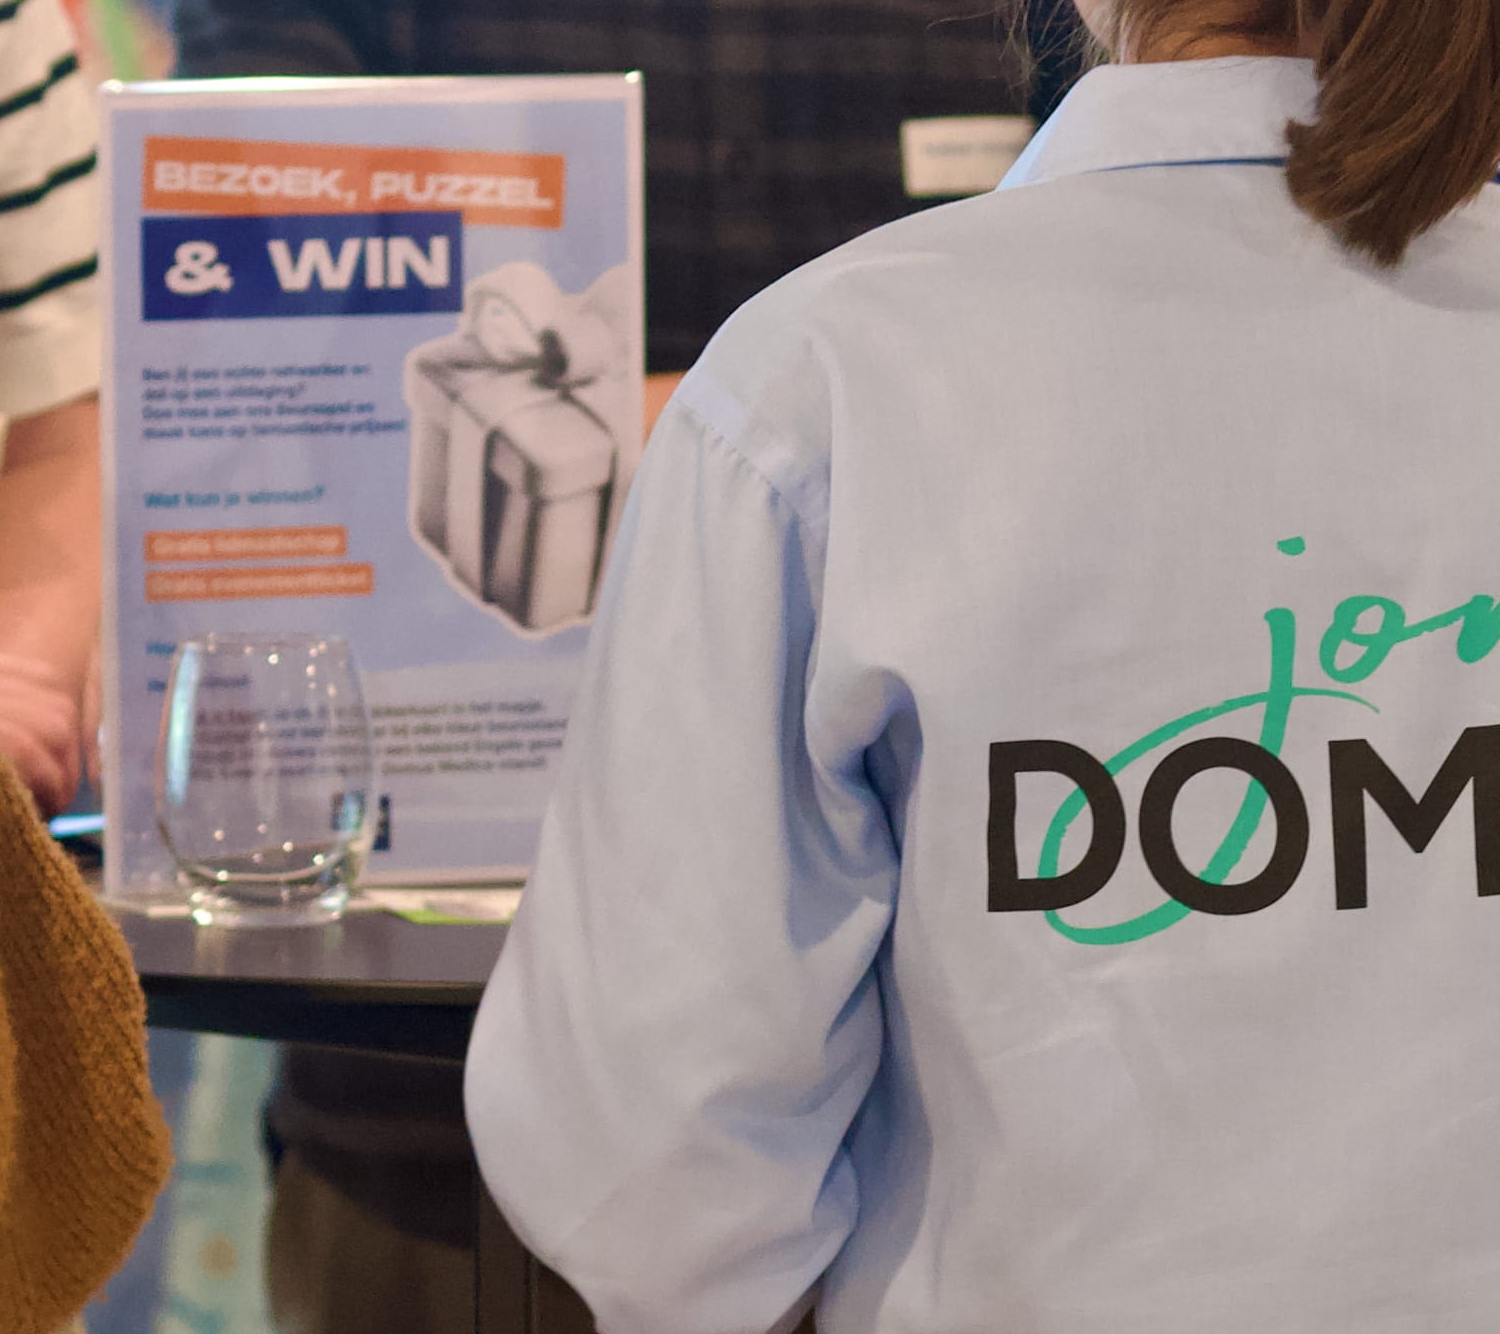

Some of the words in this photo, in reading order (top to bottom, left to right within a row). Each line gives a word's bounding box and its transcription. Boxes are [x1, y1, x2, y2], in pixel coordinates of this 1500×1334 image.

[152, 160, 358, 205] BEZOEK,
[371, 171, 554, 210] PUZZEL
[164, 240, 234, 295] &
[267, 235, 452, 292] WIN
